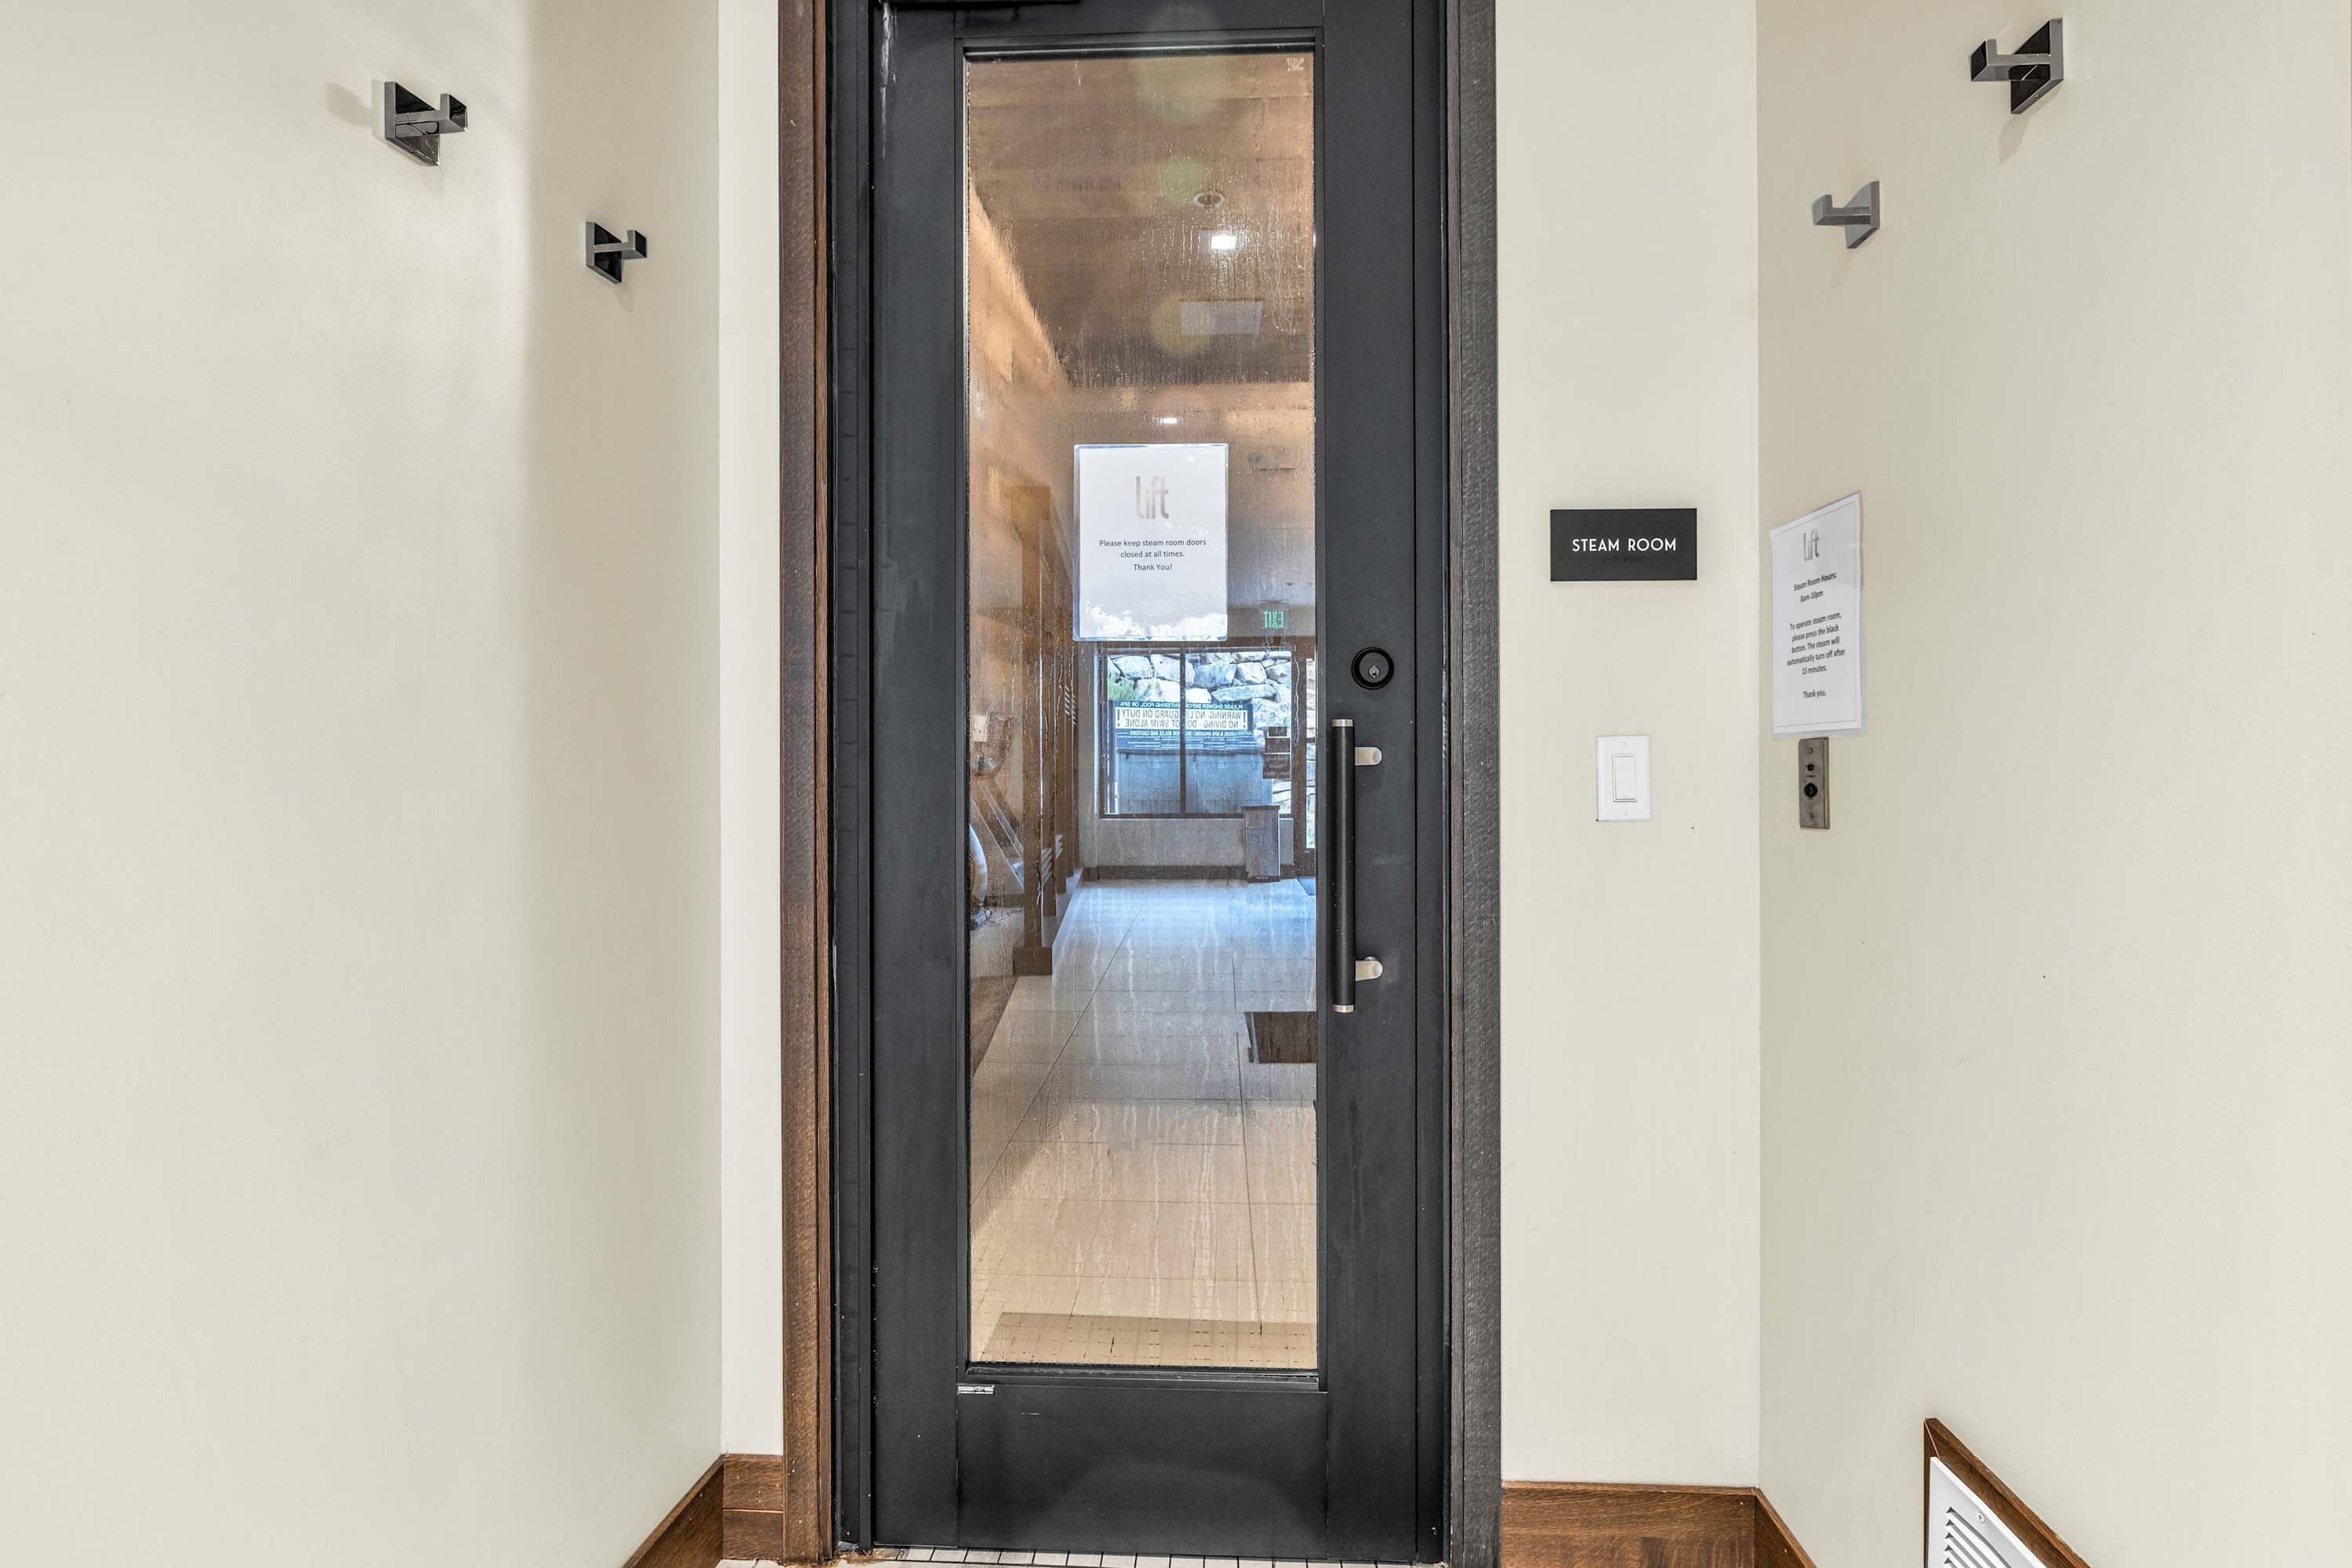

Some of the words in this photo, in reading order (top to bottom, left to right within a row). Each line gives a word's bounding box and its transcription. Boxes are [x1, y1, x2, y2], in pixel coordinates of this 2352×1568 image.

[1136, 476, 1169, 519] lift
[1572, 538, 1620, 552] STEAM
[1628, 537, 1676, 551] ROOM
[1803, 528, 1820, 561] lift
[1794, 583, 1806, 591] Steam
[1807, 578, 1820, 586] Room
[1821, 572, 1837, 582] Hours:
[1795, 619, 1811, 630] operate
[1813, 616, 1826, 625] steam
[1792, 633, 1805, 642] please
[1806, 630, 1817, 640] press
[1827, 624, 1838, 633] black
[1817, 640, 1830, 648] steam
[1788, 654, 1814, 666] automatically
[1834, 648, 1846, 657] after
[1817, 690, 1827, 699] you.
